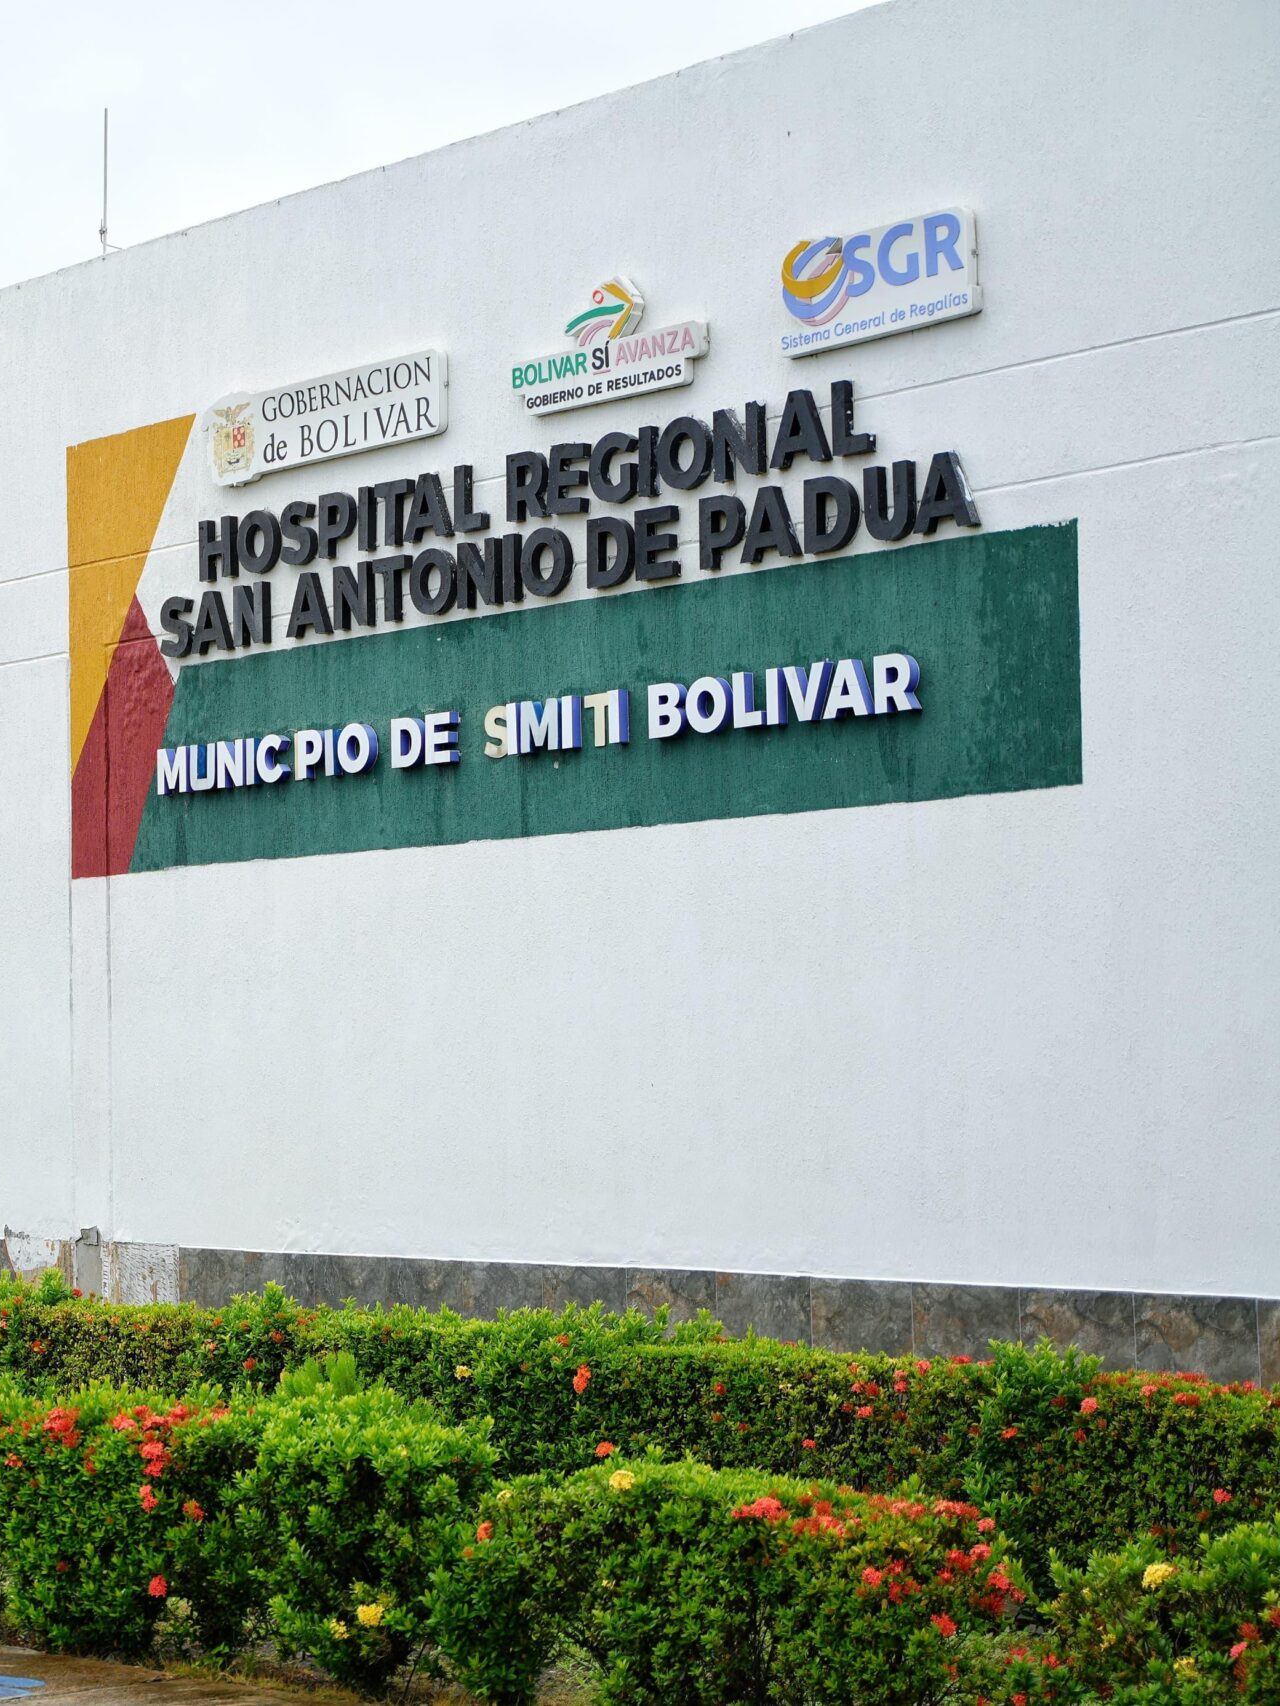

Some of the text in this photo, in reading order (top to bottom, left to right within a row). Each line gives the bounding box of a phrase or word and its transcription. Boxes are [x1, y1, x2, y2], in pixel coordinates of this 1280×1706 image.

[781, 292, 969, 351] Sistema General de Regalías
[261, 356, 433, 422] GOBERNACION
[512, 327, 696, 389] BOLIVAR SÍ AVANZA
[526, 364, 682, 409] GOBIERNO DE RESULTADOS
[263, 396, 437, 464] de BOLIVAR
[198, 380, 877, 582] HOSPITAL REGIONAL
[160, 451, 982, 658] SAN ANTONIO DE PADUA
[391, 710, 462, 769] DE
[648, 653, 923, 740] BOLIVAR
